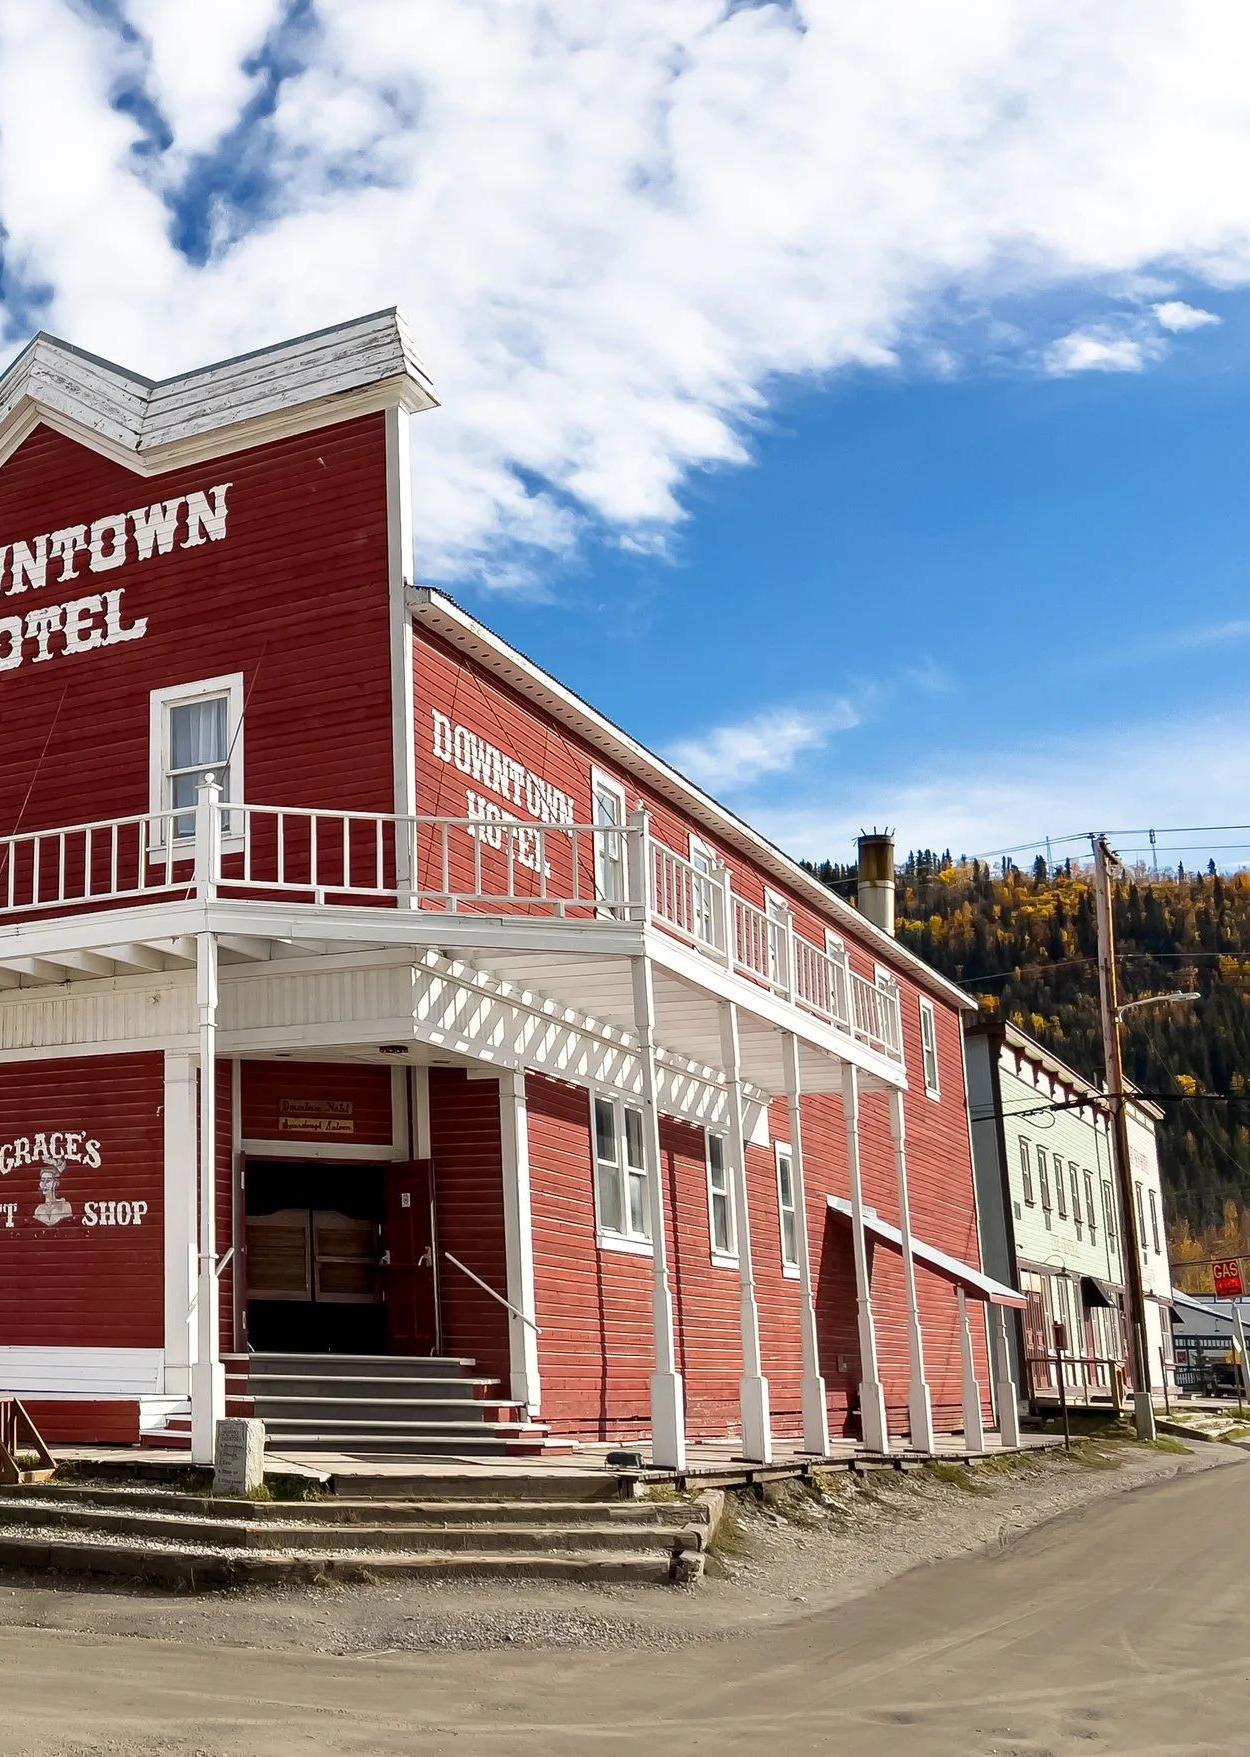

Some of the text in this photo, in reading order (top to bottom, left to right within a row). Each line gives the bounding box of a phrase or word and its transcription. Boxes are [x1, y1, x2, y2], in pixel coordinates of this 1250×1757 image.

[431, 708, 575, 838] DOWNTOWN
[81, 1200, 148, 1226] SHOP
[1213, 1262, 1238, 1278] GAS
